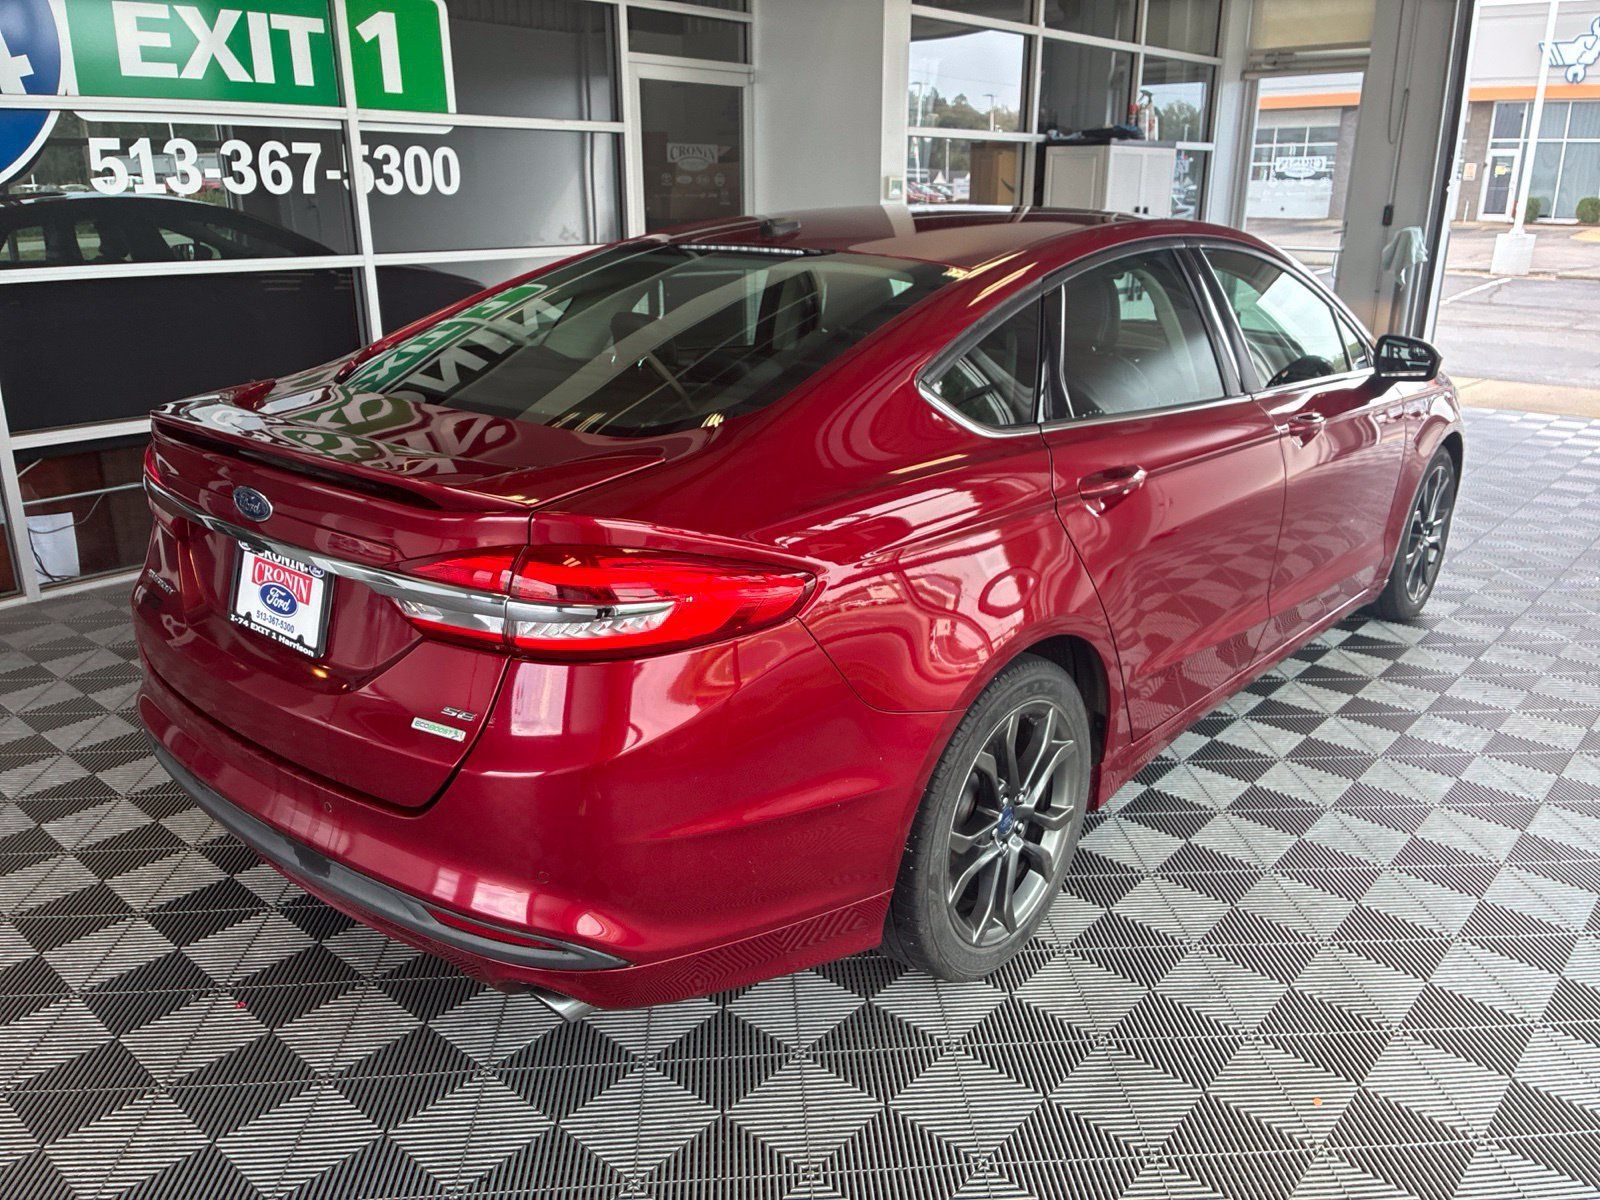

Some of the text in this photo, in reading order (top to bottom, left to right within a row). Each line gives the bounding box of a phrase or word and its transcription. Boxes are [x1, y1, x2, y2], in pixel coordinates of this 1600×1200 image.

[111, 0, 325, 87] EXIT
[355, 11, 403, 95] 1
[88, 137, 461, 196] 513-367-5300
[254, 561, 310, 603] CRONIN
[266, 587, 291, 612] Ford
[230, 613, 249, 628] I-74
[250, 624, 270, 636] EXIT
[278, 634, 315, 658] Harrison
[256, 610, 295, 634] 513-367-5300
